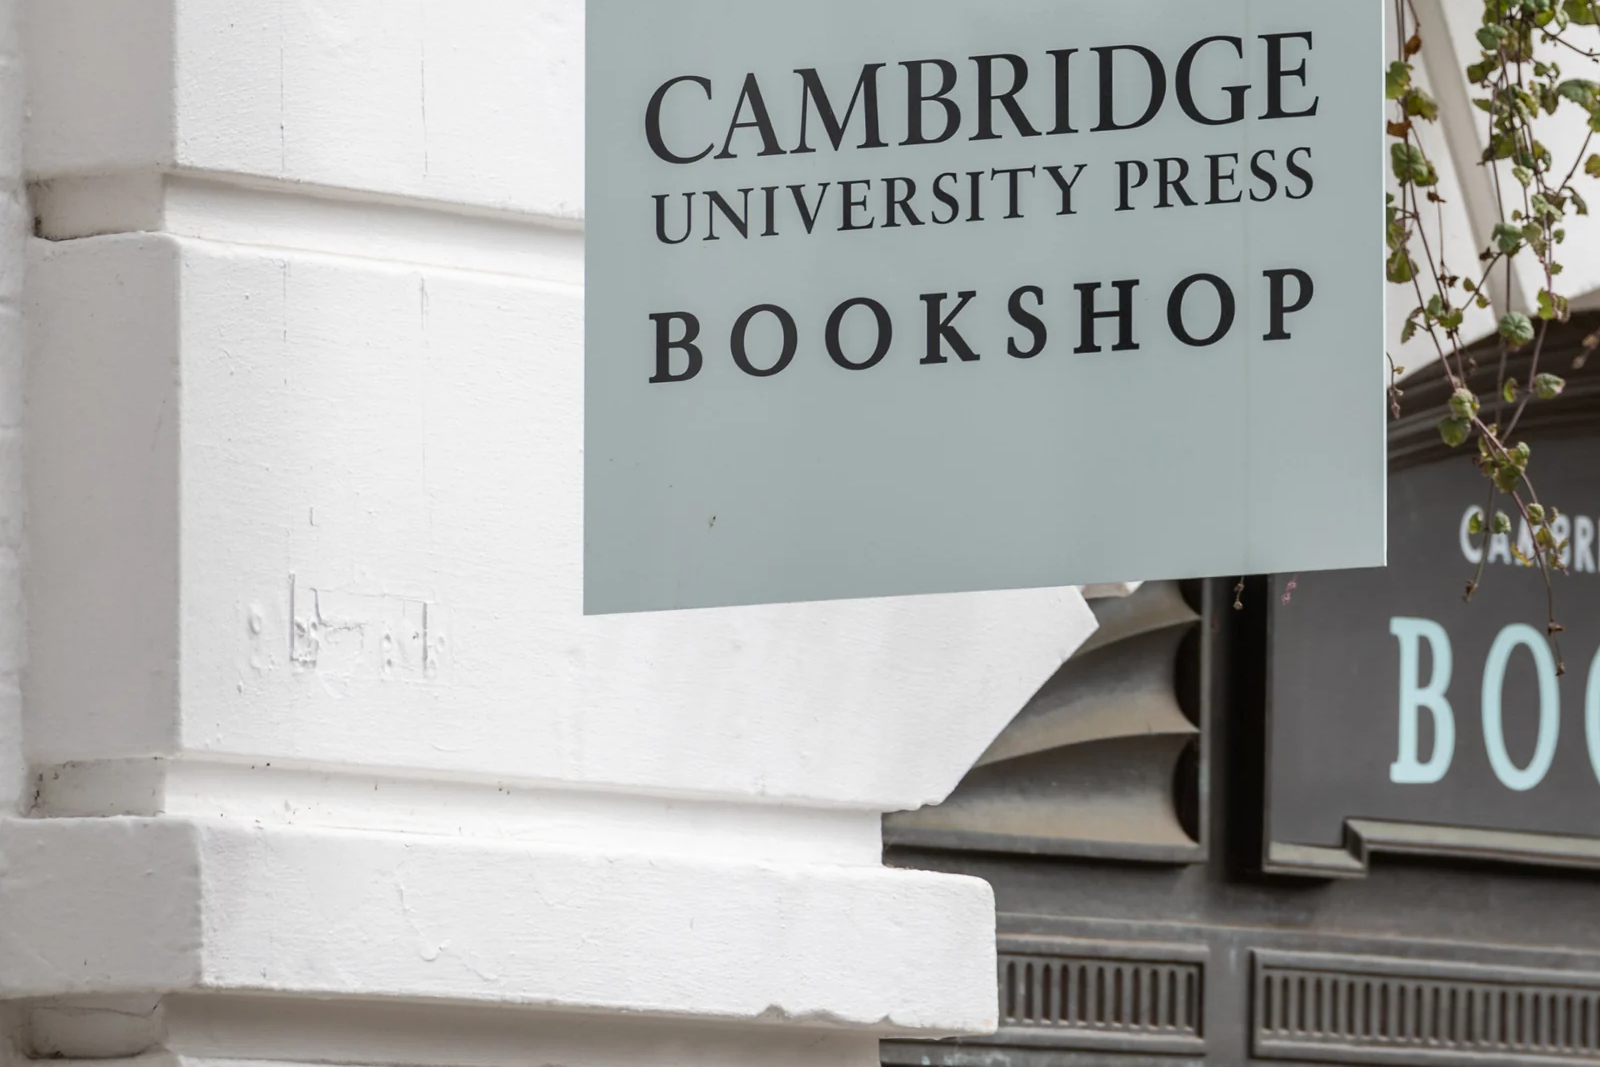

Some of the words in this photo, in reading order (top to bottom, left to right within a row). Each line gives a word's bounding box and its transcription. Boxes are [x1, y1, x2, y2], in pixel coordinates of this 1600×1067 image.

[644, 30, 1320, 165] CAMBRIDGE
[651, 163, 1088, 245] UNIVERSITY
[1114, 146, 1315, 213] PRESS
[648, 268, 1315, 384] BOOKSHOP
